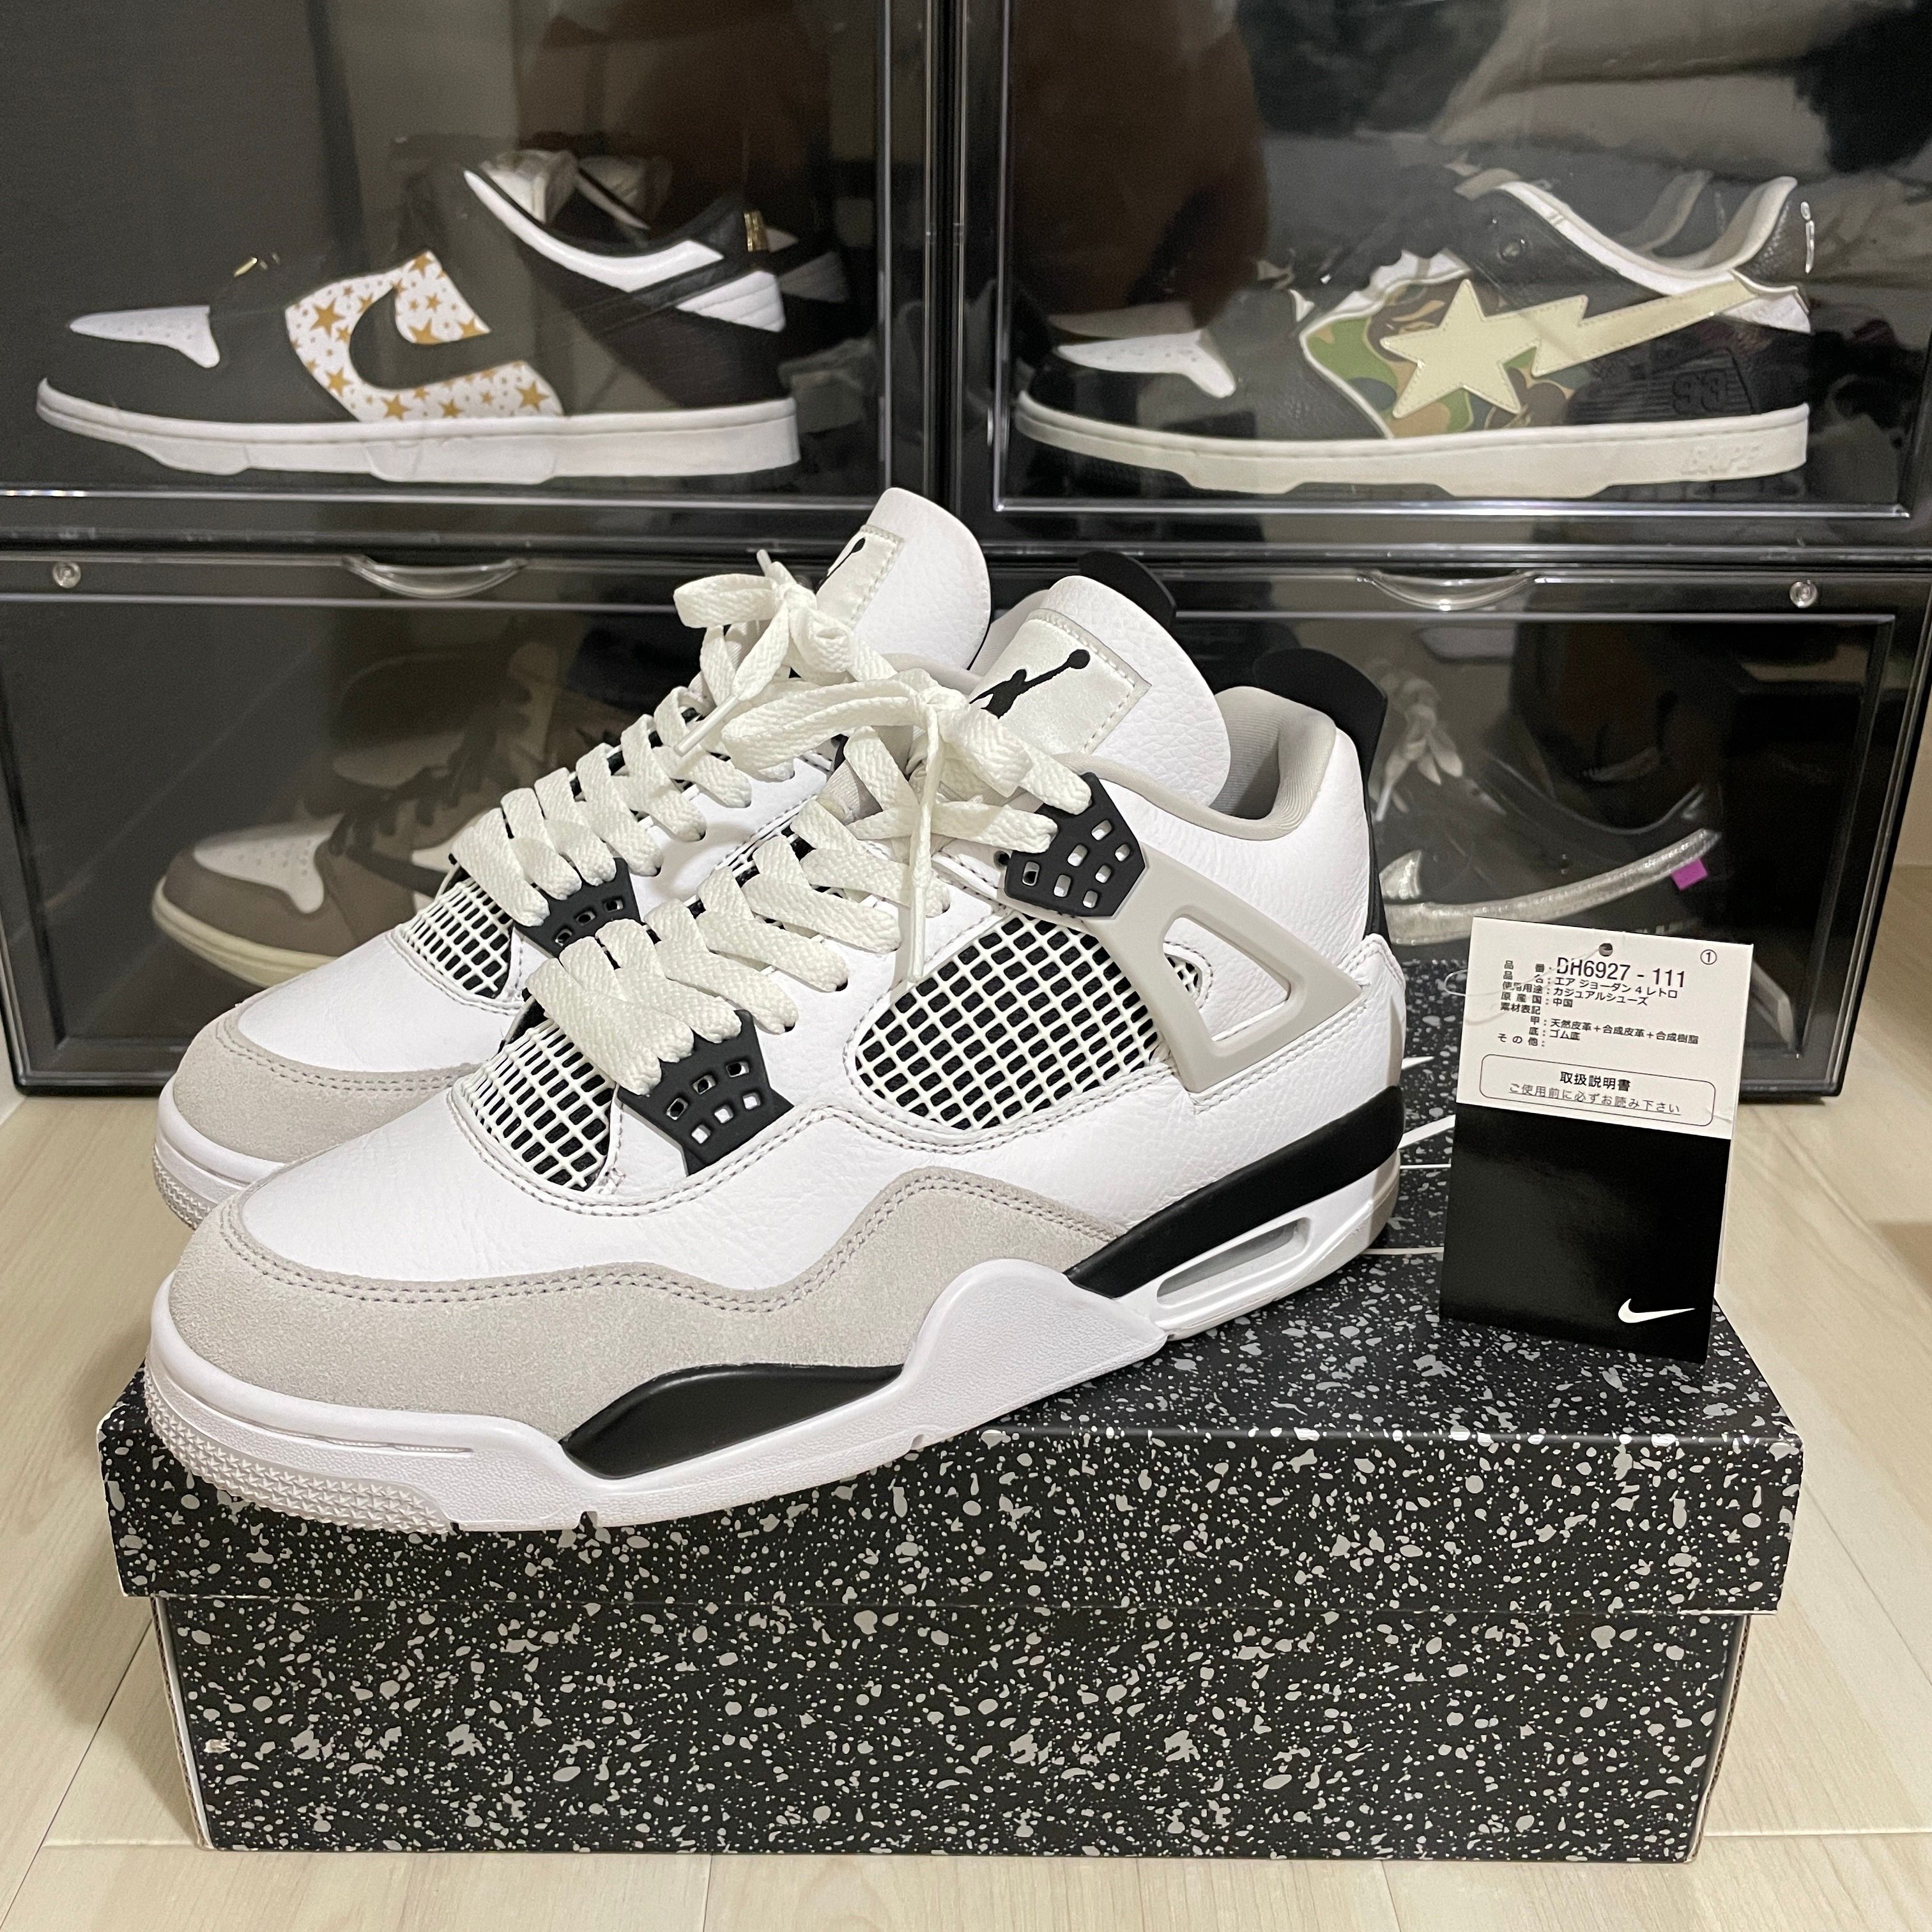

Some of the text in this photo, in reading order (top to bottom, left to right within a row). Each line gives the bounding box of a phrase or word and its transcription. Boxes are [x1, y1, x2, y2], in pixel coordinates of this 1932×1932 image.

[1560, 1071, 1631, 1092] 取扱説明書
[1508, 1083, 1681, 1114] ご使用前に必ずお読み下さい
